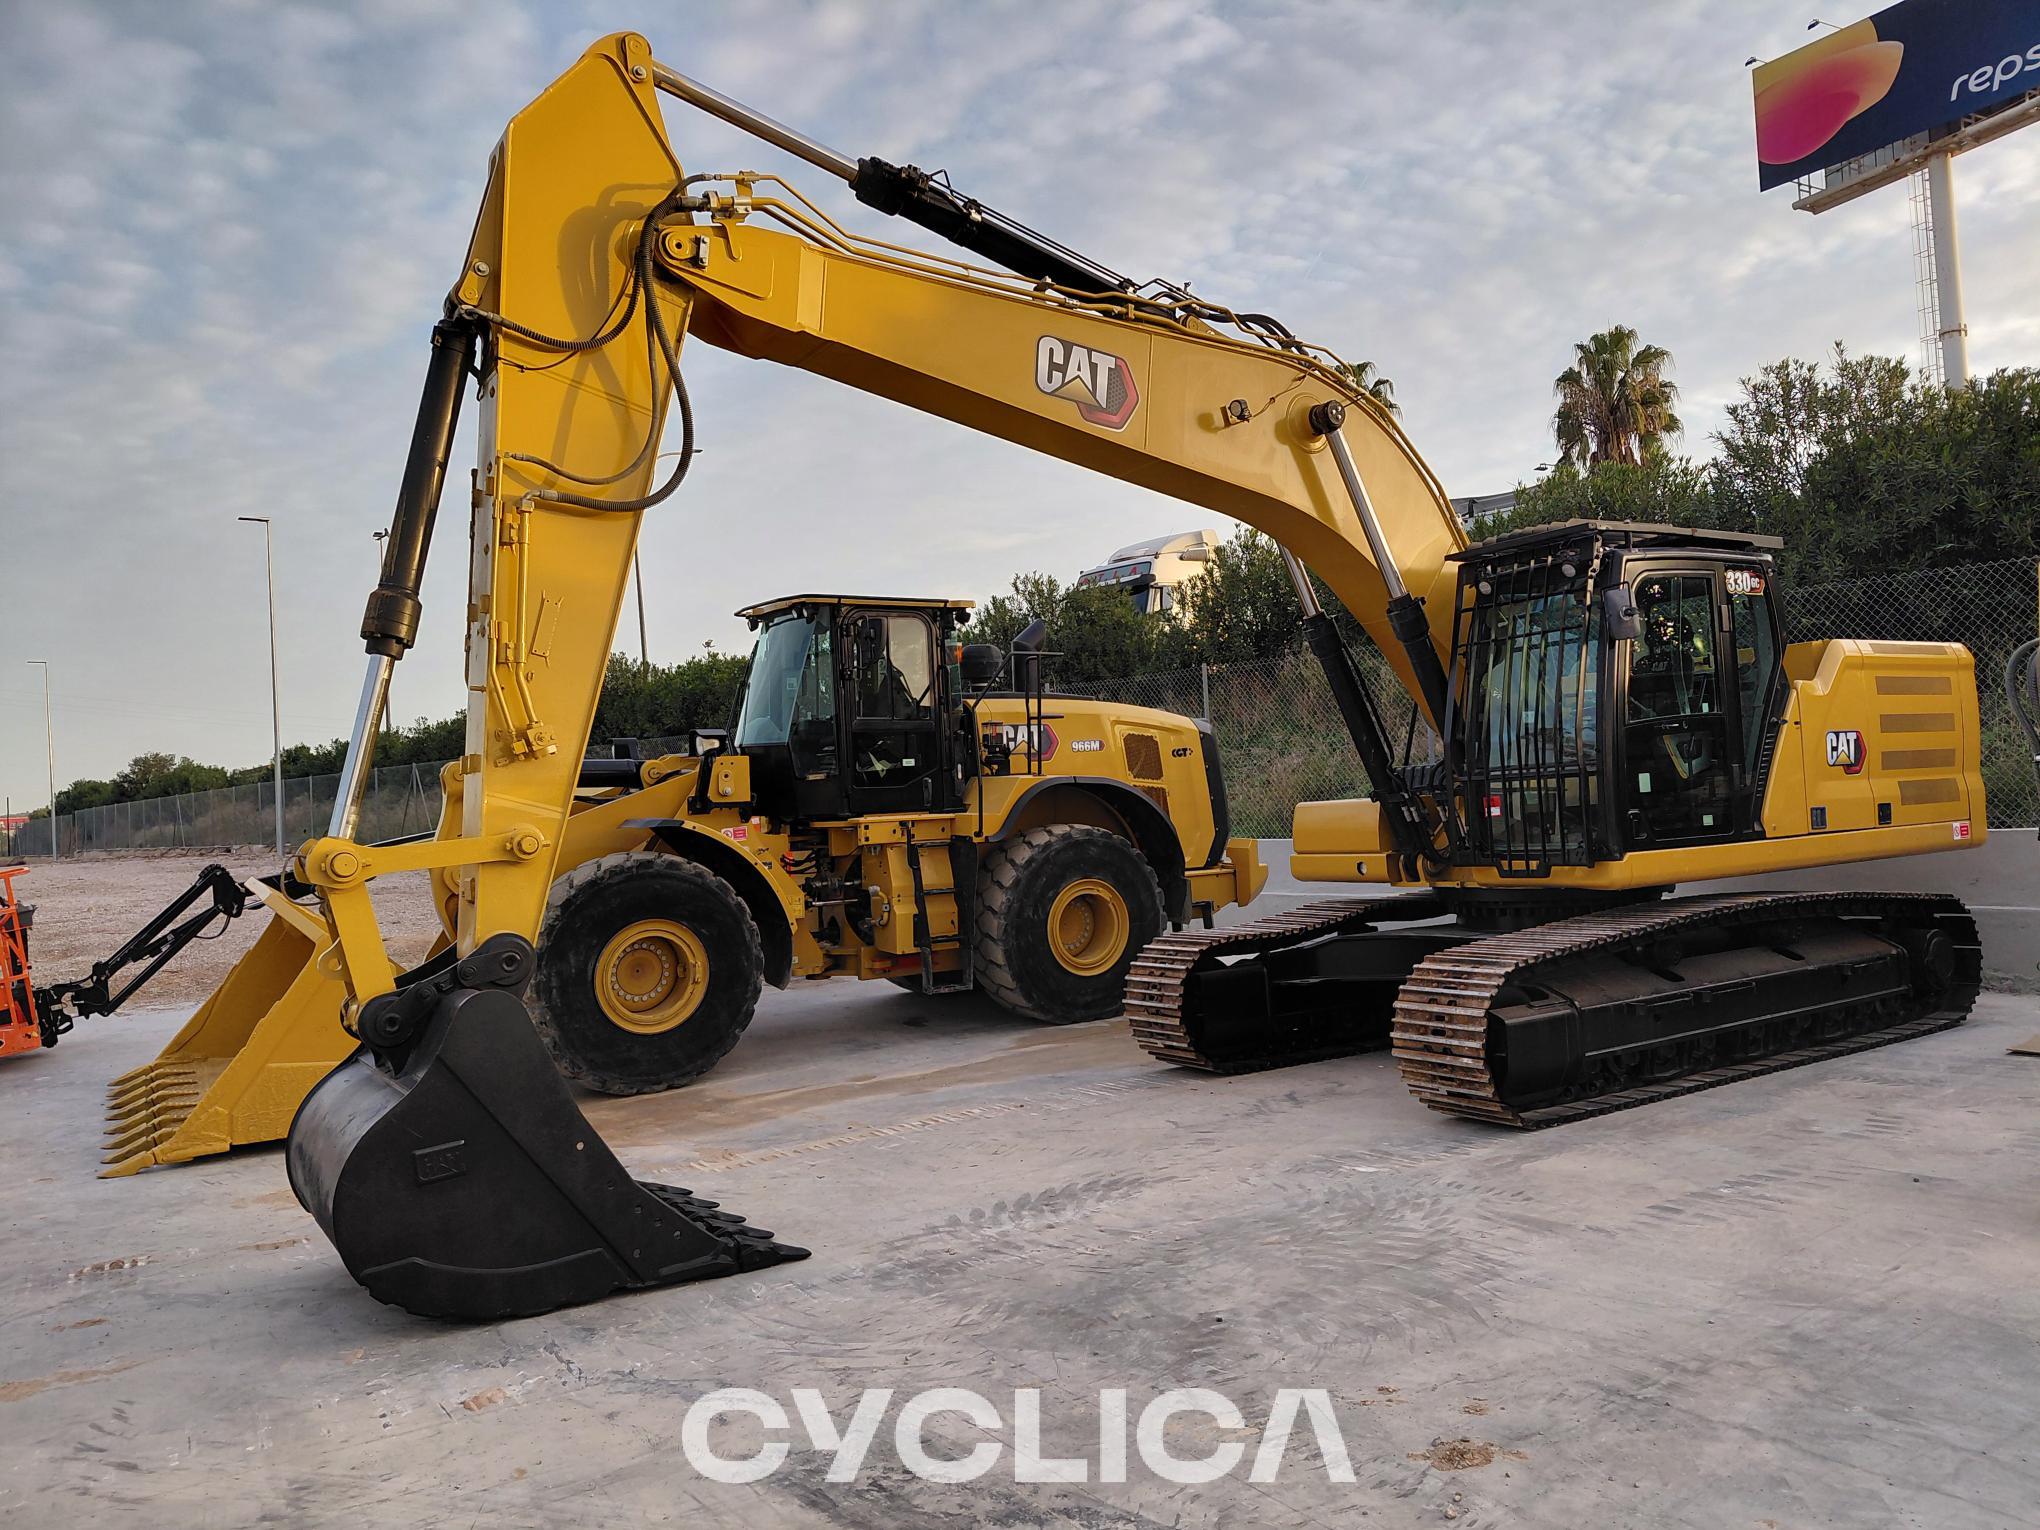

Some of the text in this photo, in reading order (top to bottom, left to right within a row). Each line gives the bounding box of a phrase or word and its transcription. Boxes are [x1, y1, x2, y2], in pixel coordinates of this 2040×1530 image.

[1037, 336, 1116, 409] CAT
[1726, 571, 1751, 593] 330
[1071, 740, 1100, 752] 966M
[1826, 732, 1857, 765] CAT
